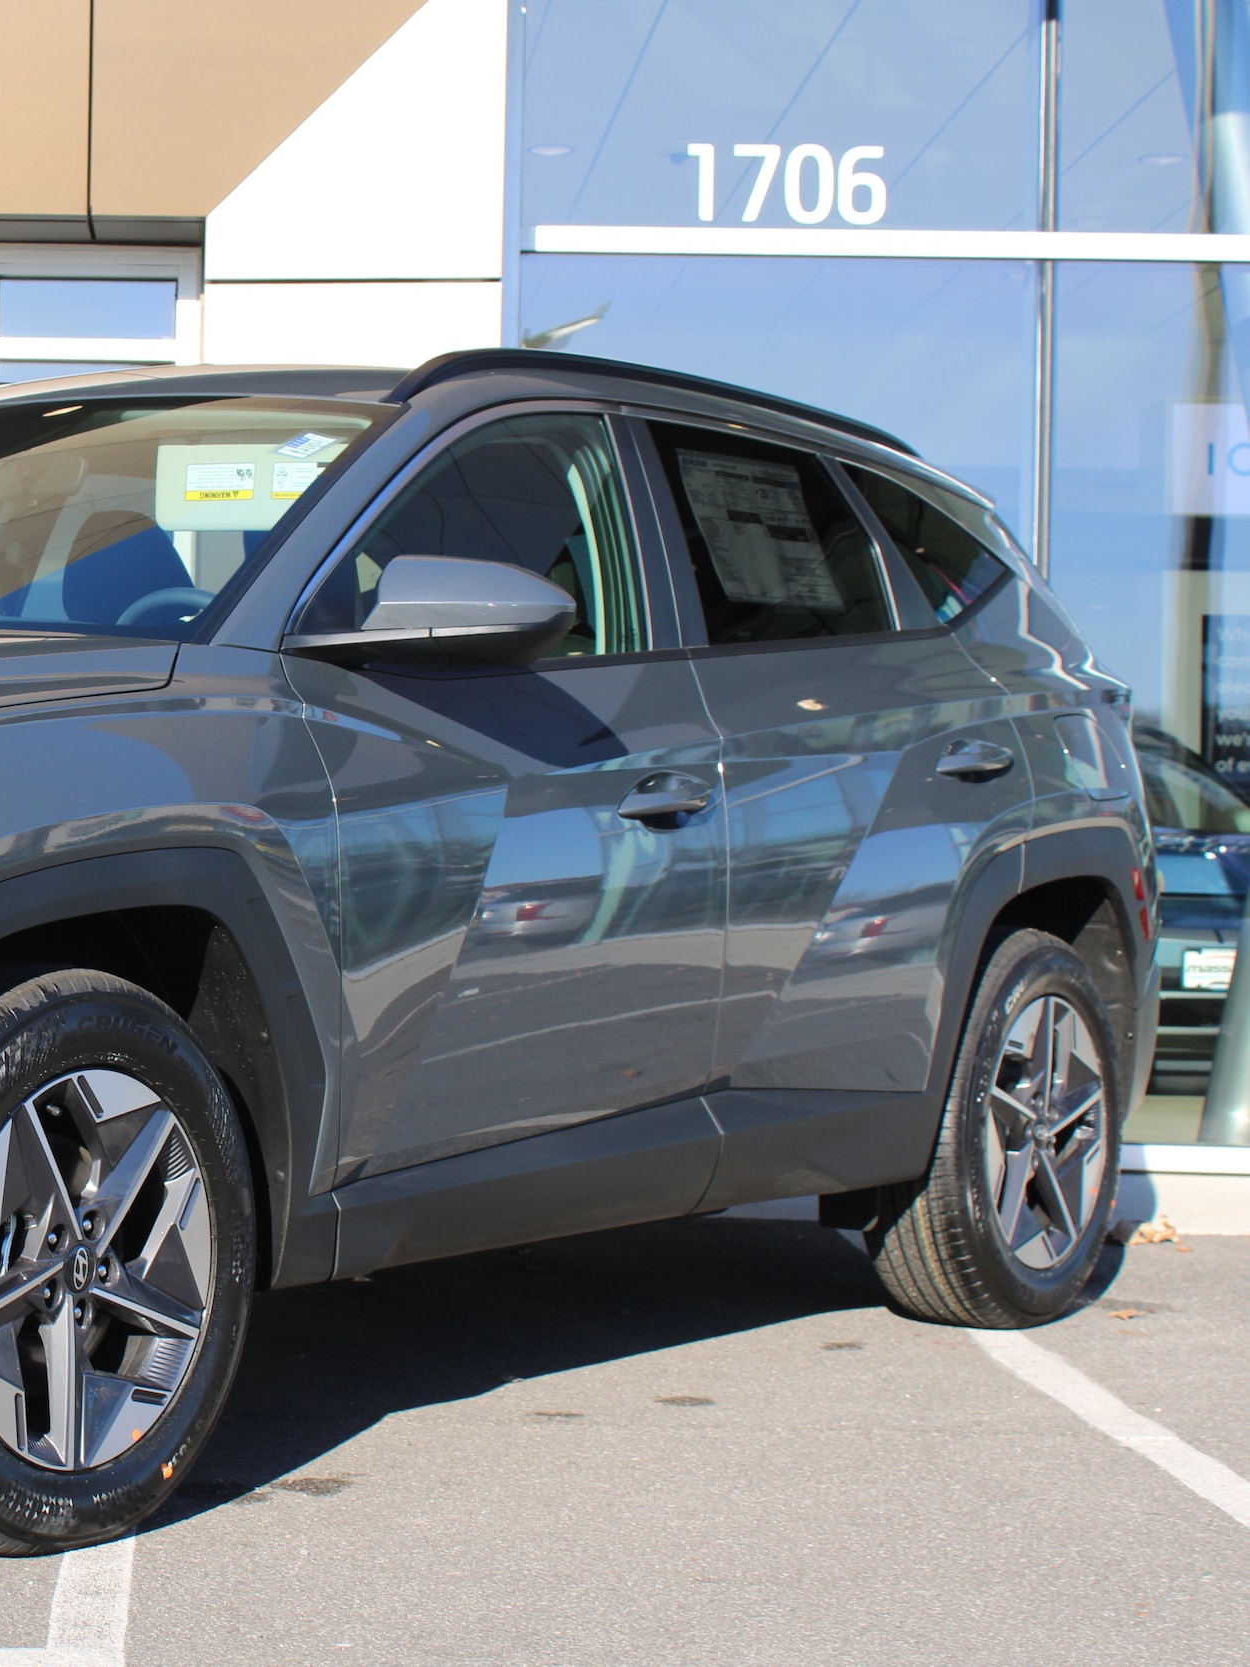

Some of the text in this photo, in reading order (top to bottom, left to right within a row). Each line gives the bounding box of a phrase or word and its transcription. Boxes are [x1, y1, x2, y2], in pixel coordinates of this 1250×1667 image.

[687, 143, 888, 226] 1706
[199, 491, 231, 499] WARNING
[1214, 757, 1234, 773] of
